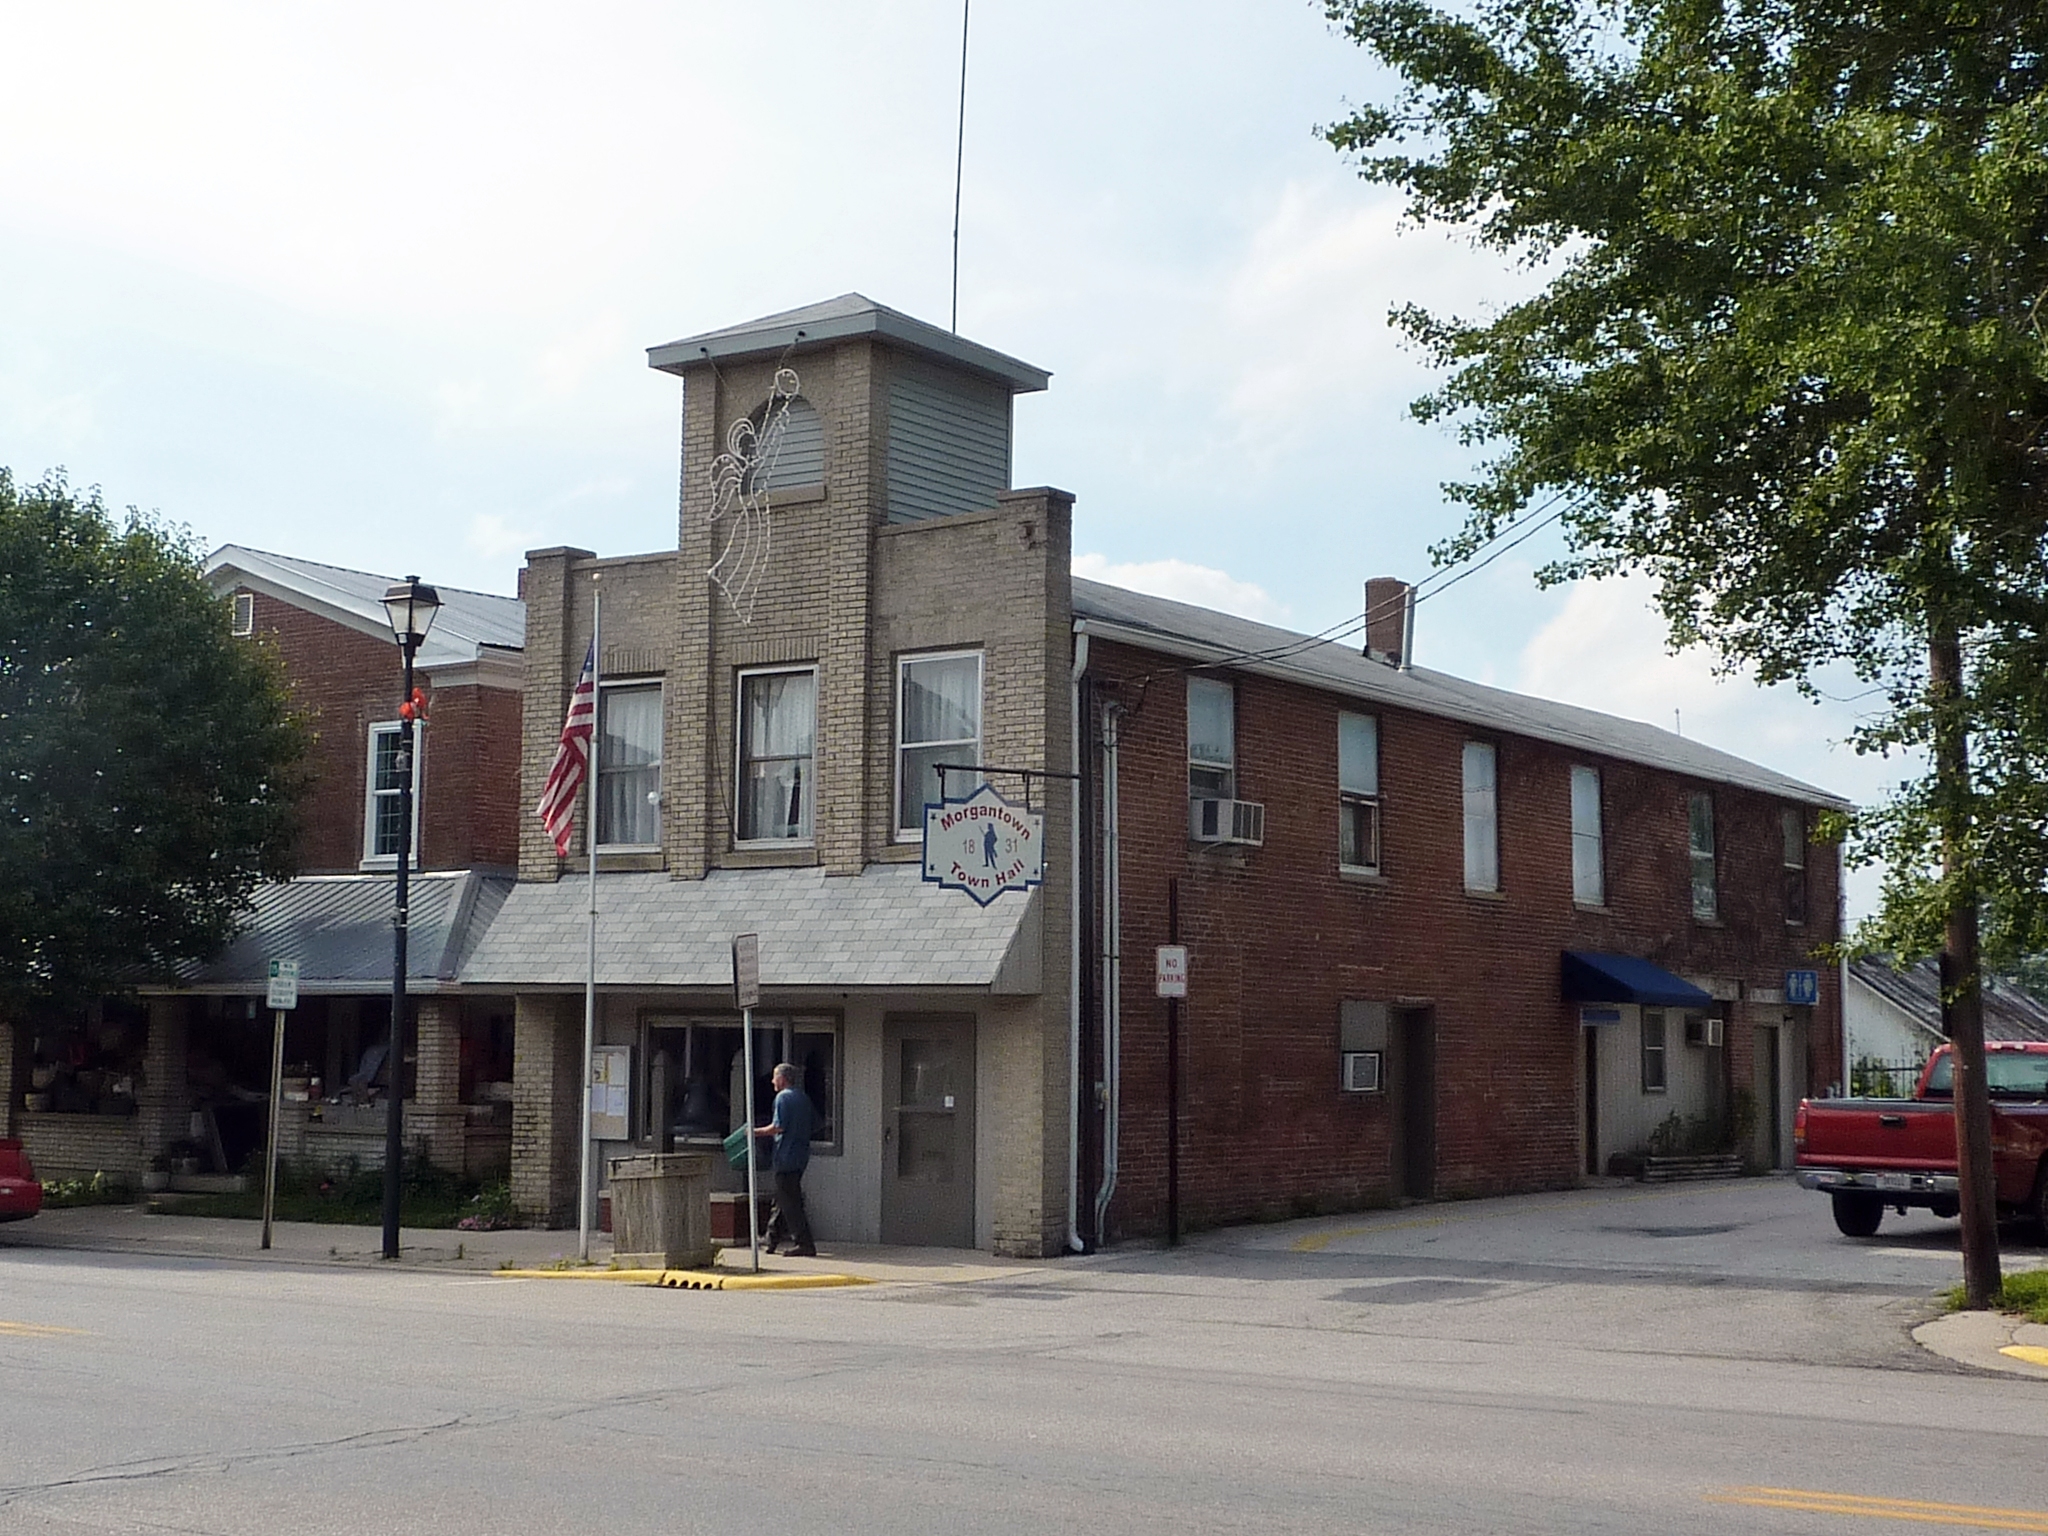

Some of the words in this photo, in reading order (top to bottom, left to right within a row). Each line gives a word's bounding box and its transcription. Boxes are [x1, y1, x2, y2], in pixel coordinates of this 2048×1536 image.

[941, 805, 1031, 840] Morgantown
[962, 839, 975, 854] 18
[1005, 838, 1018, 853] 31
[950, 861, 989, 888] Town
[995, 859, 1025, 885] Hall
[1165, 959, 1178, 968] NO
